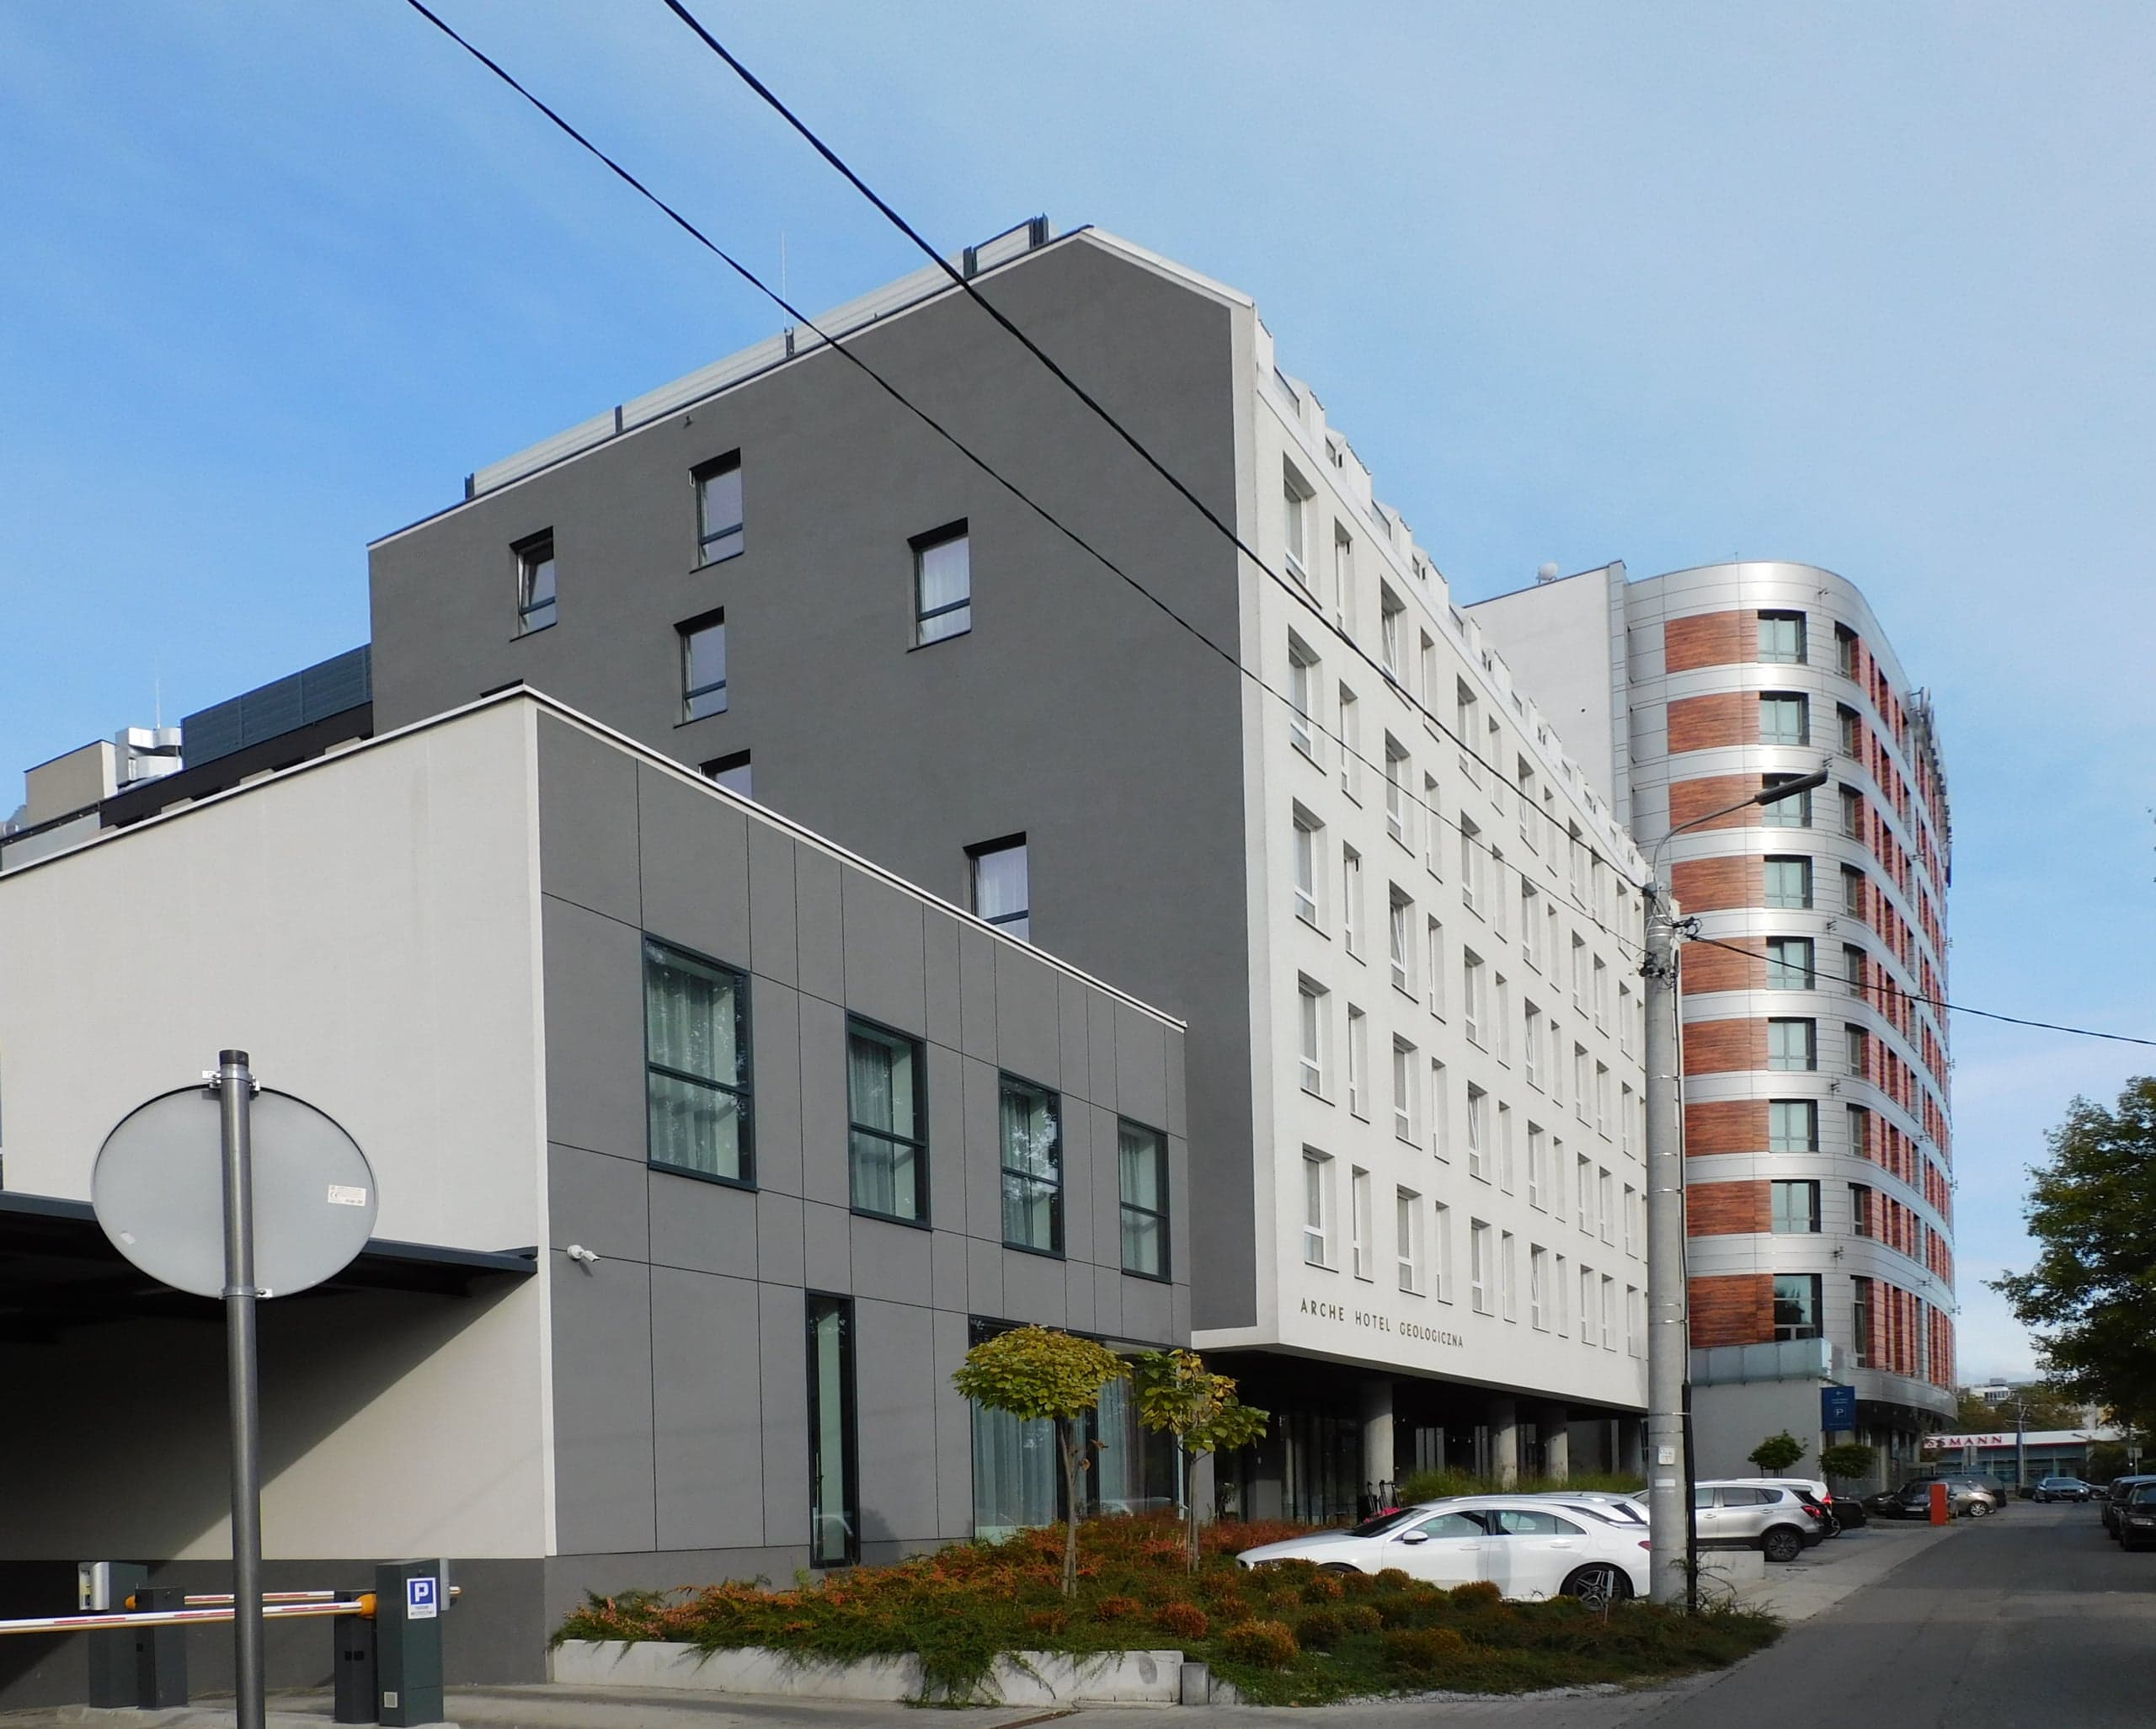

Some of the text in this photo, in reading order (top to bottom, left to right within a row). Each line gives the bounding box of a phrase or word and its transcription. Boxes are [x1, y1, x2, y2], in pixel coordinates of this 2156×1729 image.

[1300, 1297, 1464, 1348] ARCHE HOTEL GEOLOGICZNA
[414, 1582, 430, 1603] P
